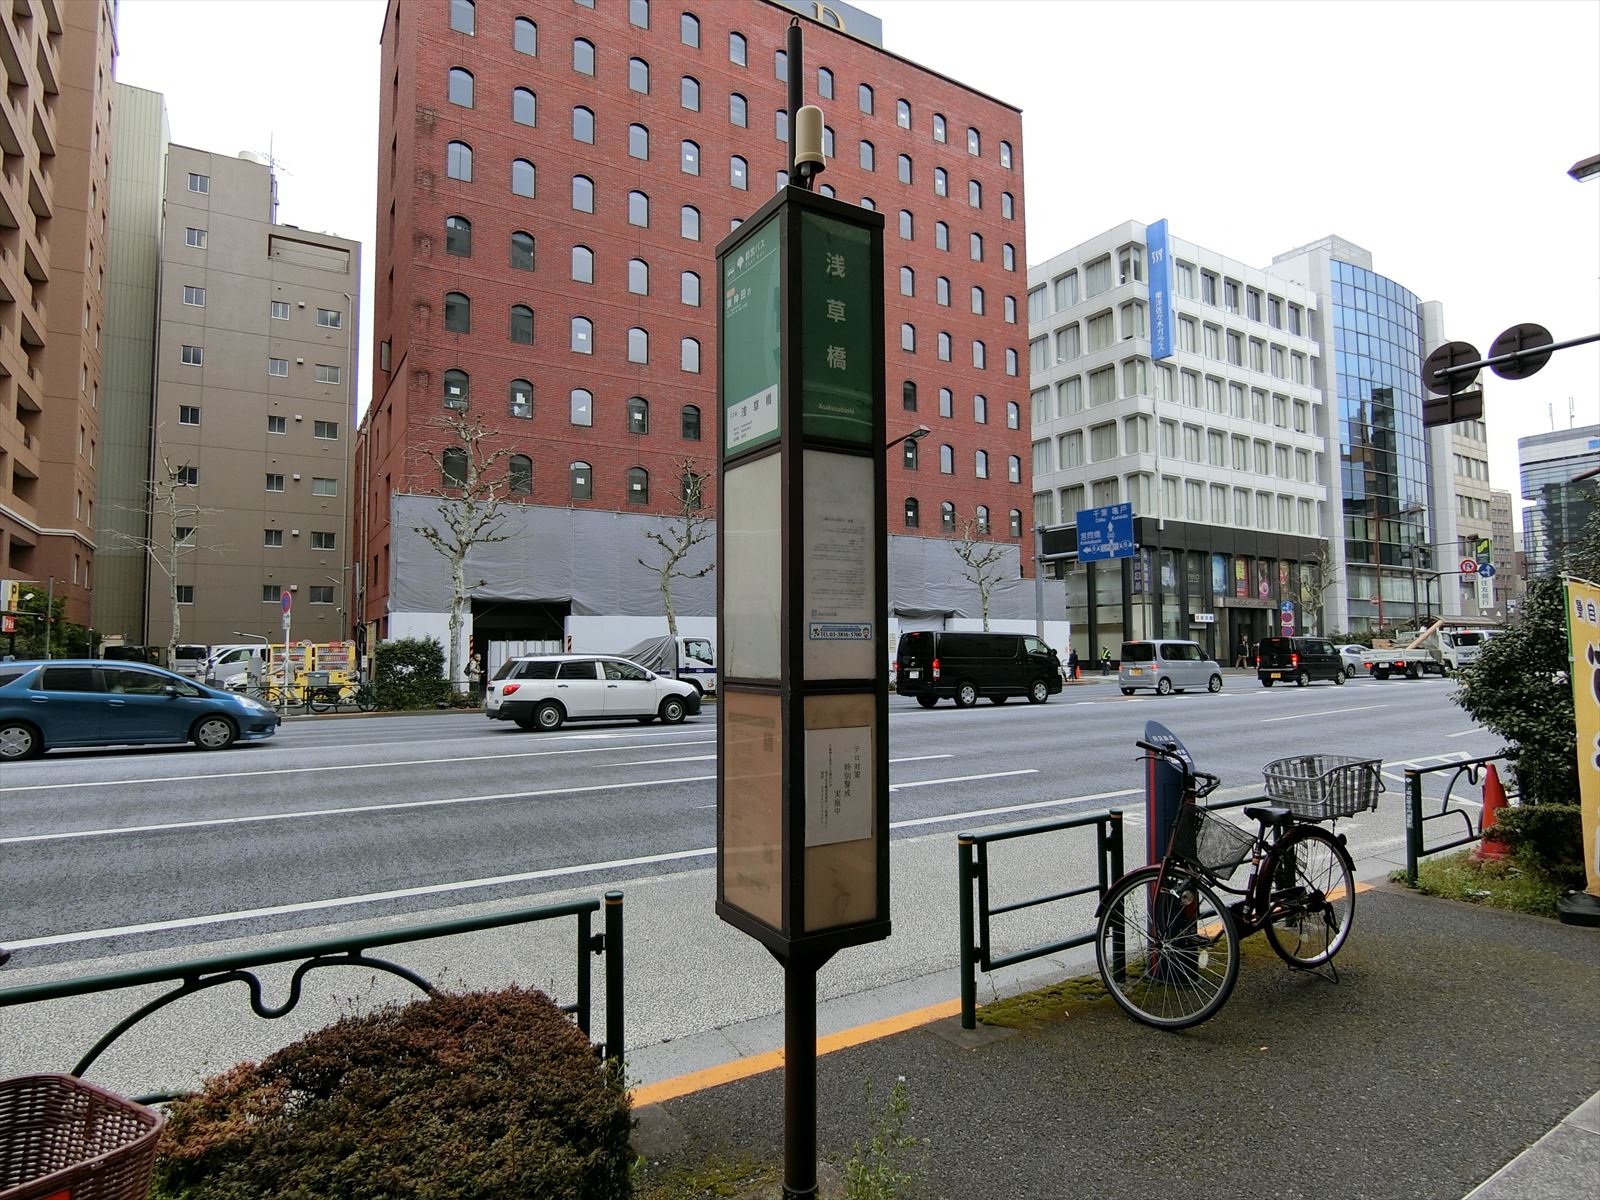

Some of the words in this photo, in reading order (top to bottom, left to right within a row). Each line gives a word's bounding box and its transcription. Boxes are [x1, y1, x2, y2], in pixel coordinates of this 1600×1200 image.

[826, 252, 847, 371] 浅草橋
[1481, 577, 1489, 606] 住友銀行
